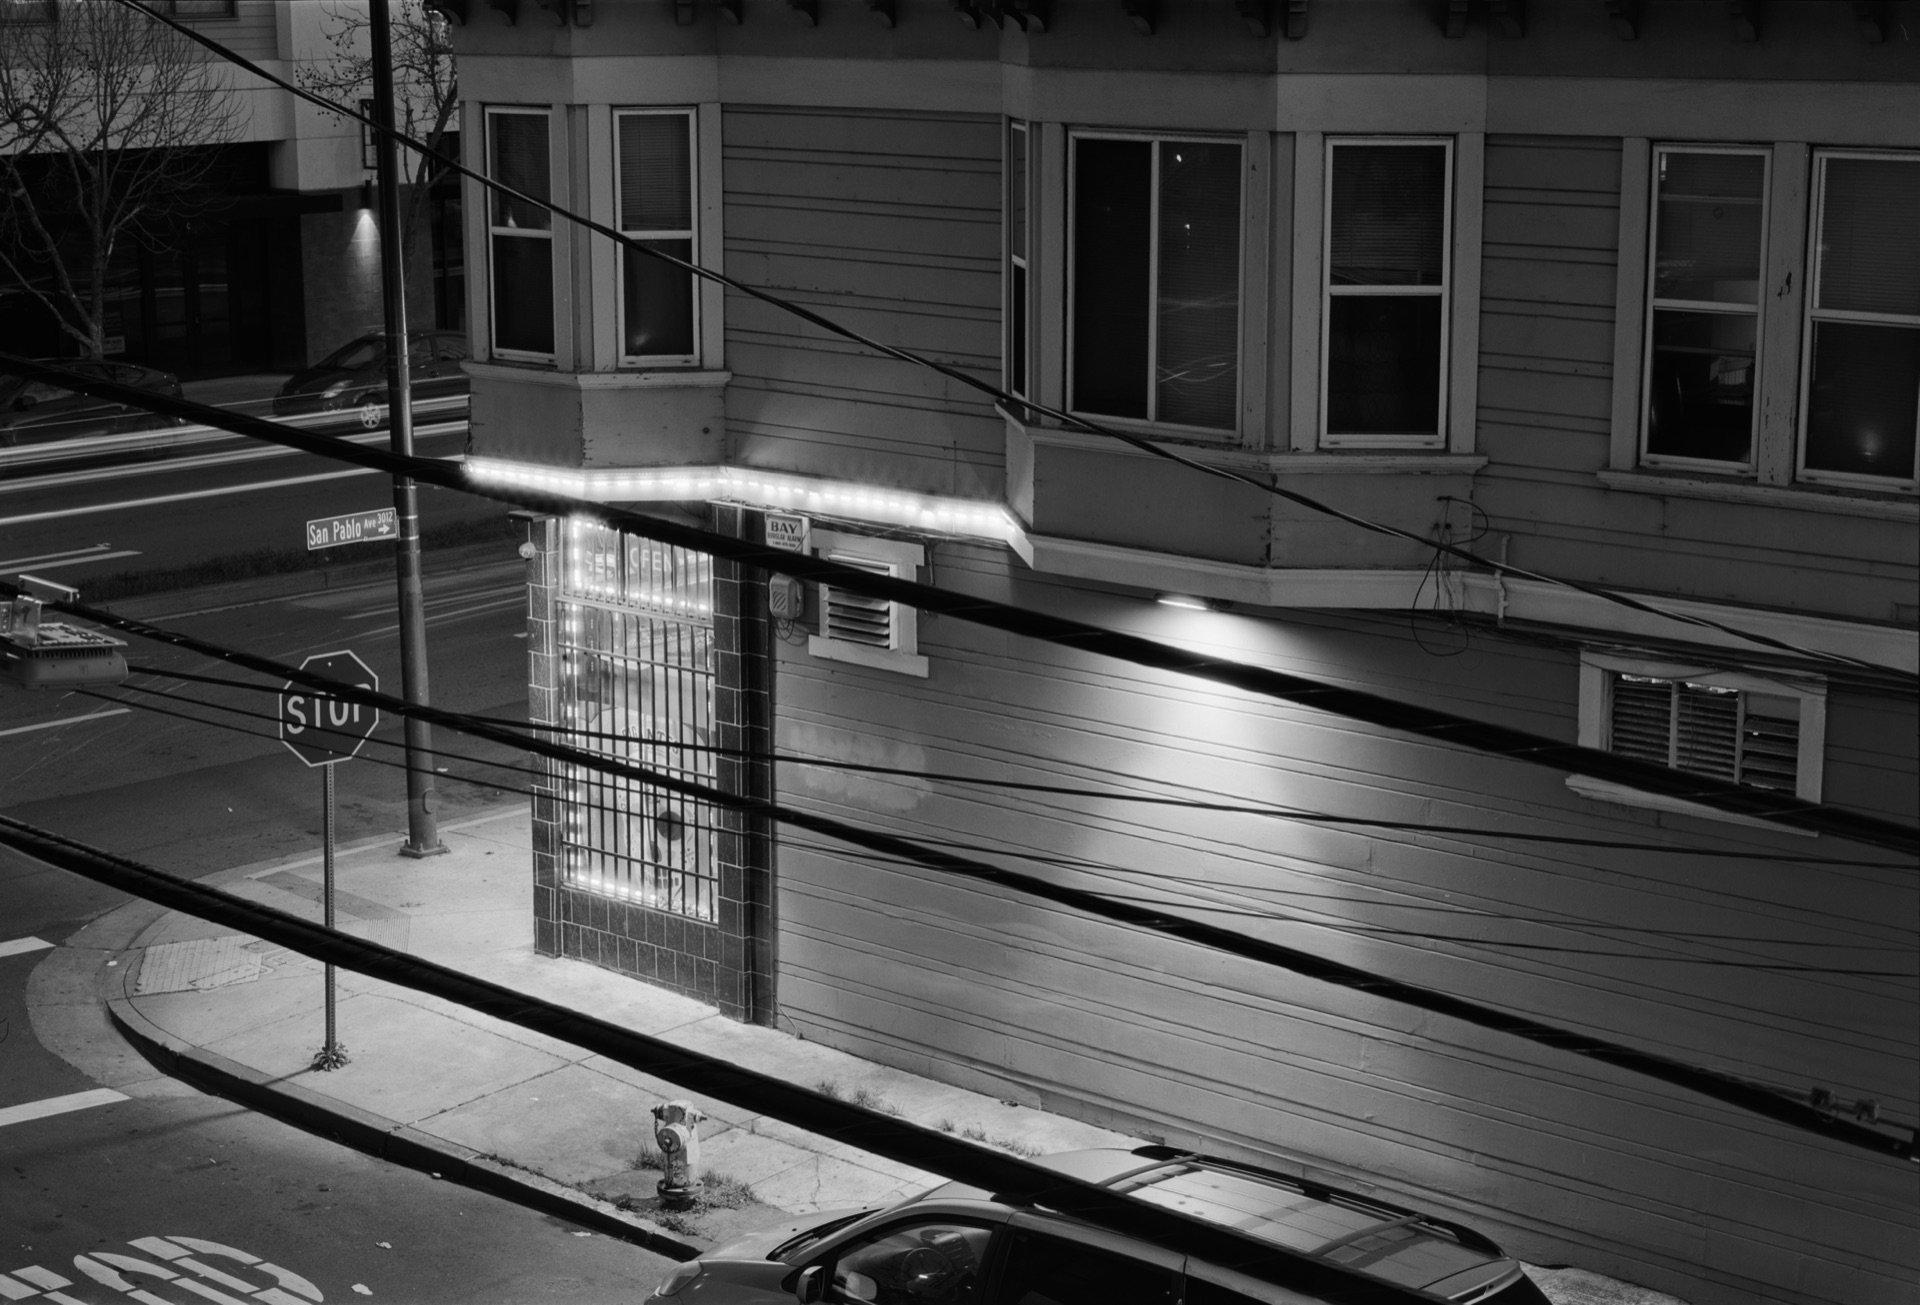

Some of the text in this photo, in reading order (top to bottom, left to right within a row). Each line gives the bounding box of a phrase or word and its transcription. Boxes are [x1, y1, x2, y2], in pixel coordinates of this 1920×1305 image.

[309, 511, 393, 545] San Pablo Ave 3012
[771, 521, 797, 534] BAY
